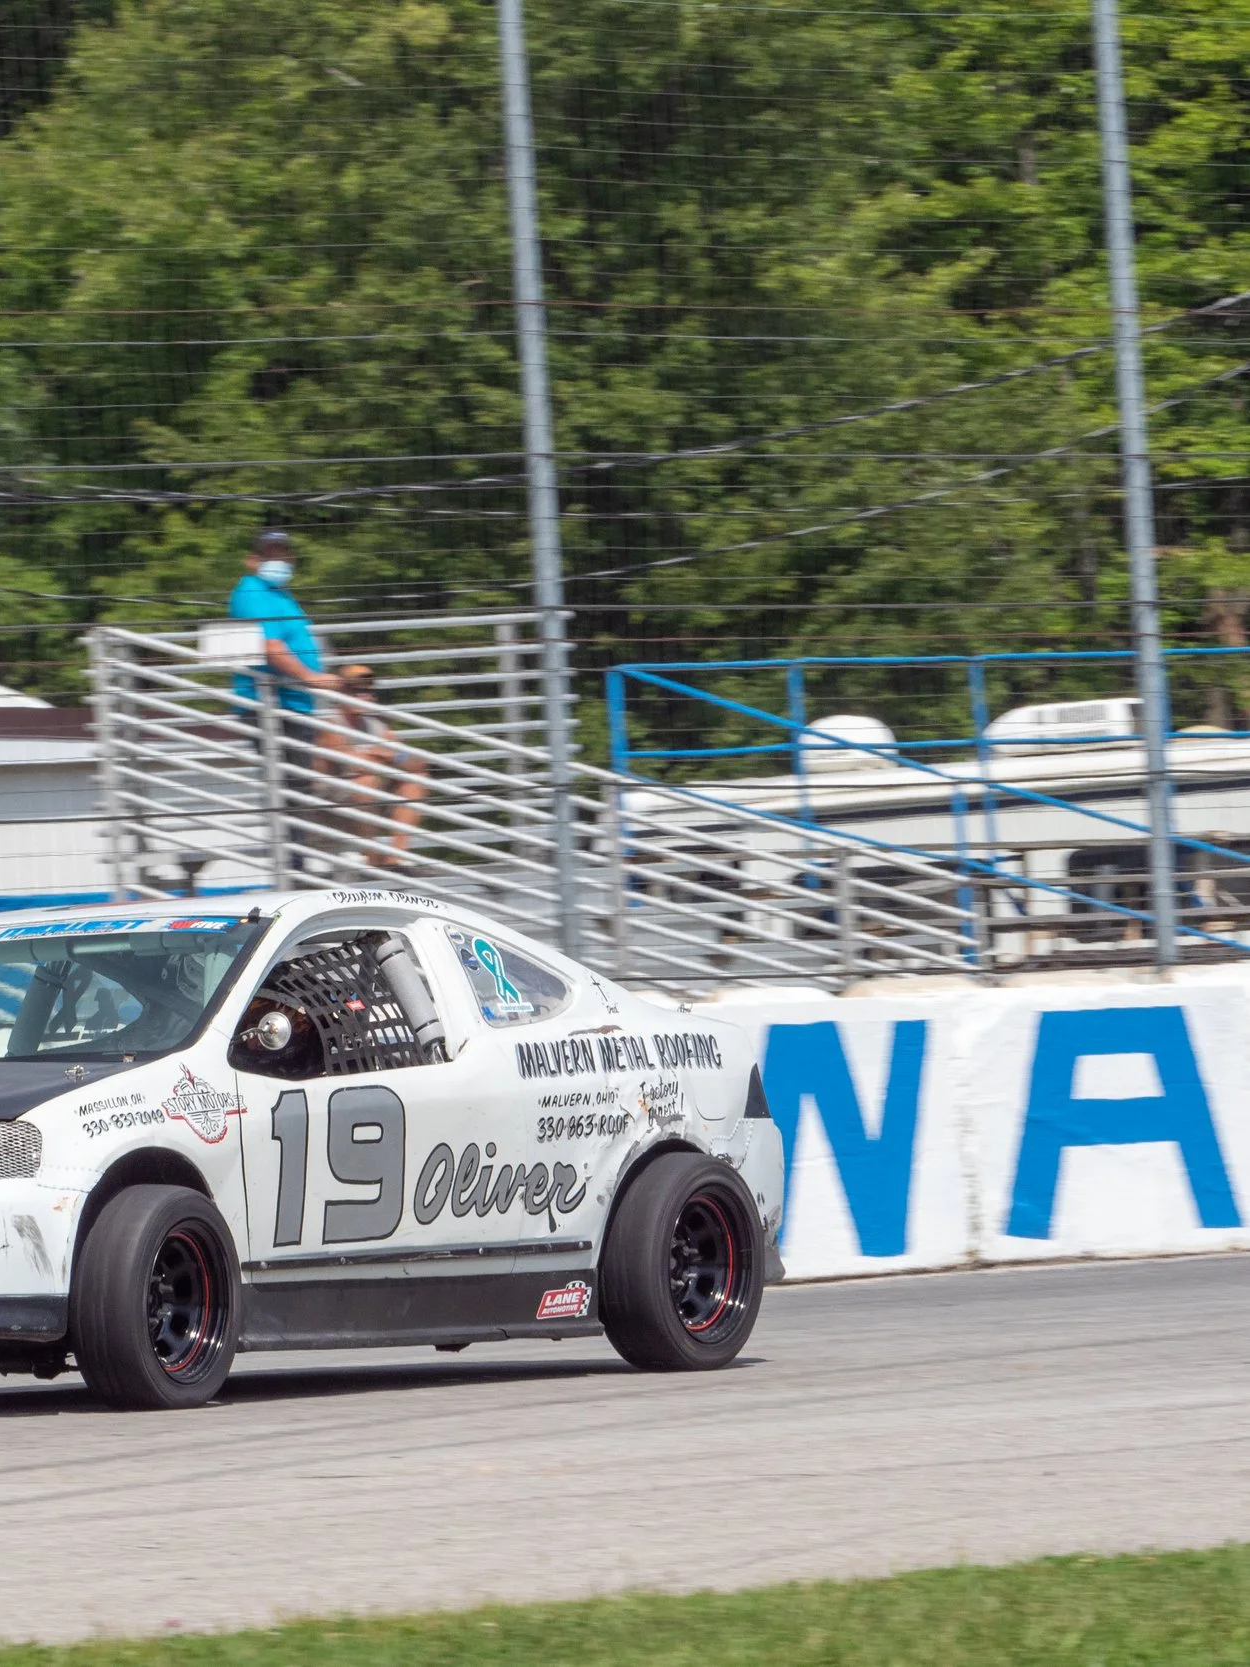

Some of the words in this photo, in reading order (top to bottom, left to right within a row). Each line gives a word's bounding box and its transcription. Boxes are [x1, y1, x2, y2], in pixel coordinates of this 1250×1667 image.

[514, 1037, 597, 1080] MALVERN
[597, 1034, 656, 1074] METAL
[651, 1032, 723, 1072] ROOFING
[167, 1096, 197, 1113] STORY
[197, 1091, 235, 1111] MOTORS
[270, 1084, 407, 1248] 19
[413, 1141, 587, 1227] Oliver
[544, 1291, 582, 1307] LANE
